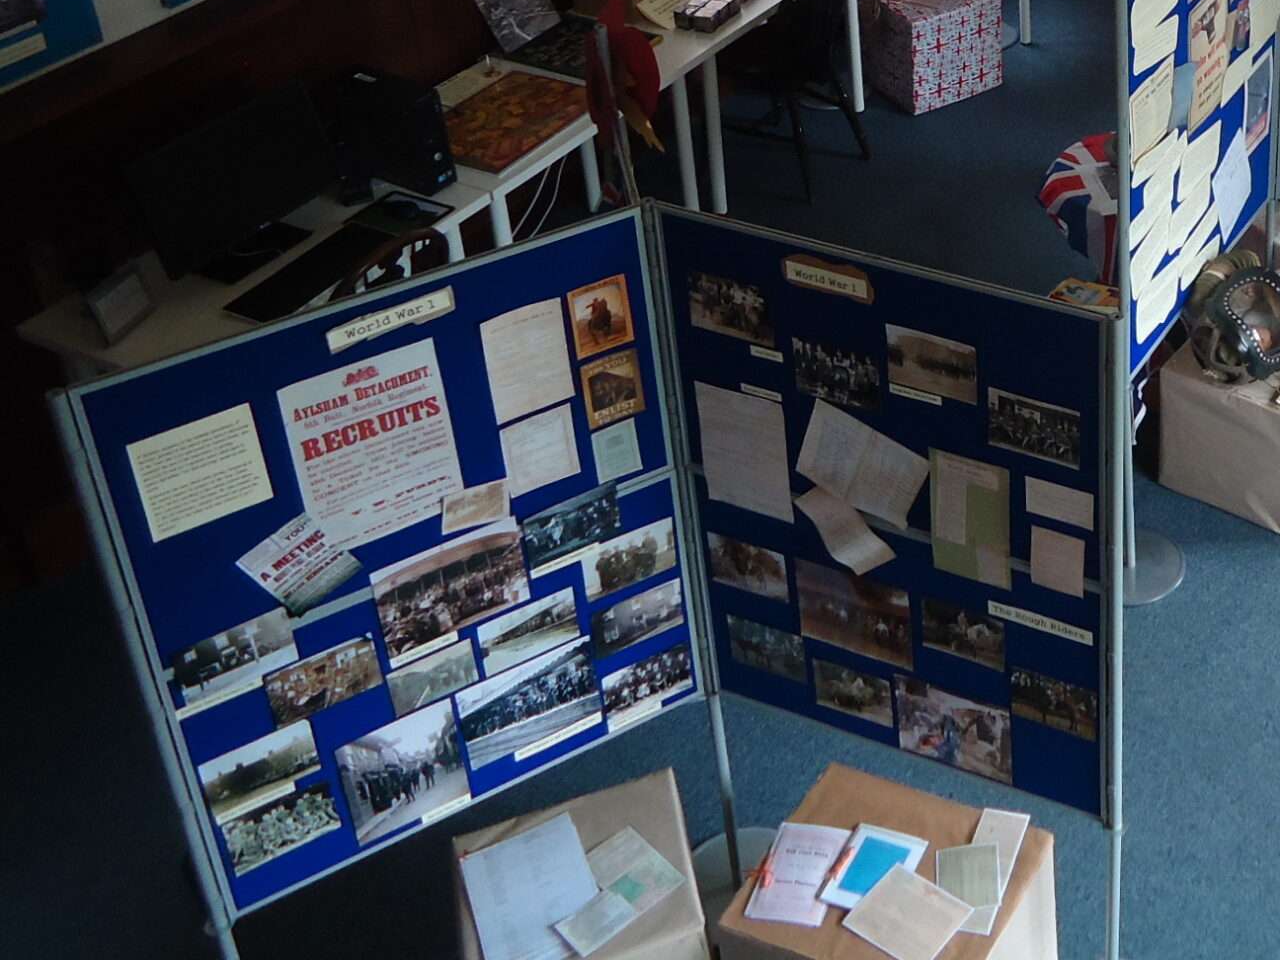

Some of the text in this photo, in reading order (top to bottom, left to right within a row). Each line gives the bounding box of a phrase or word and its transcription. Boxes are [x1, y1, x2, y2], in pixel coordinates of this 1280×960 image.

[794, 267, 826, 285] World
[828, 277, 850, 290] War
[344, 315, 391, 339] World
[394, 302, 425, 321] War
[293, 393, 350, 423] AYLSHAM
[301, 396, 441, 461] RECRUITS
[260, 572, 272, 583] A
[272, 530, 325, 571] MEETING
[991, 604, 1013, 617] The
